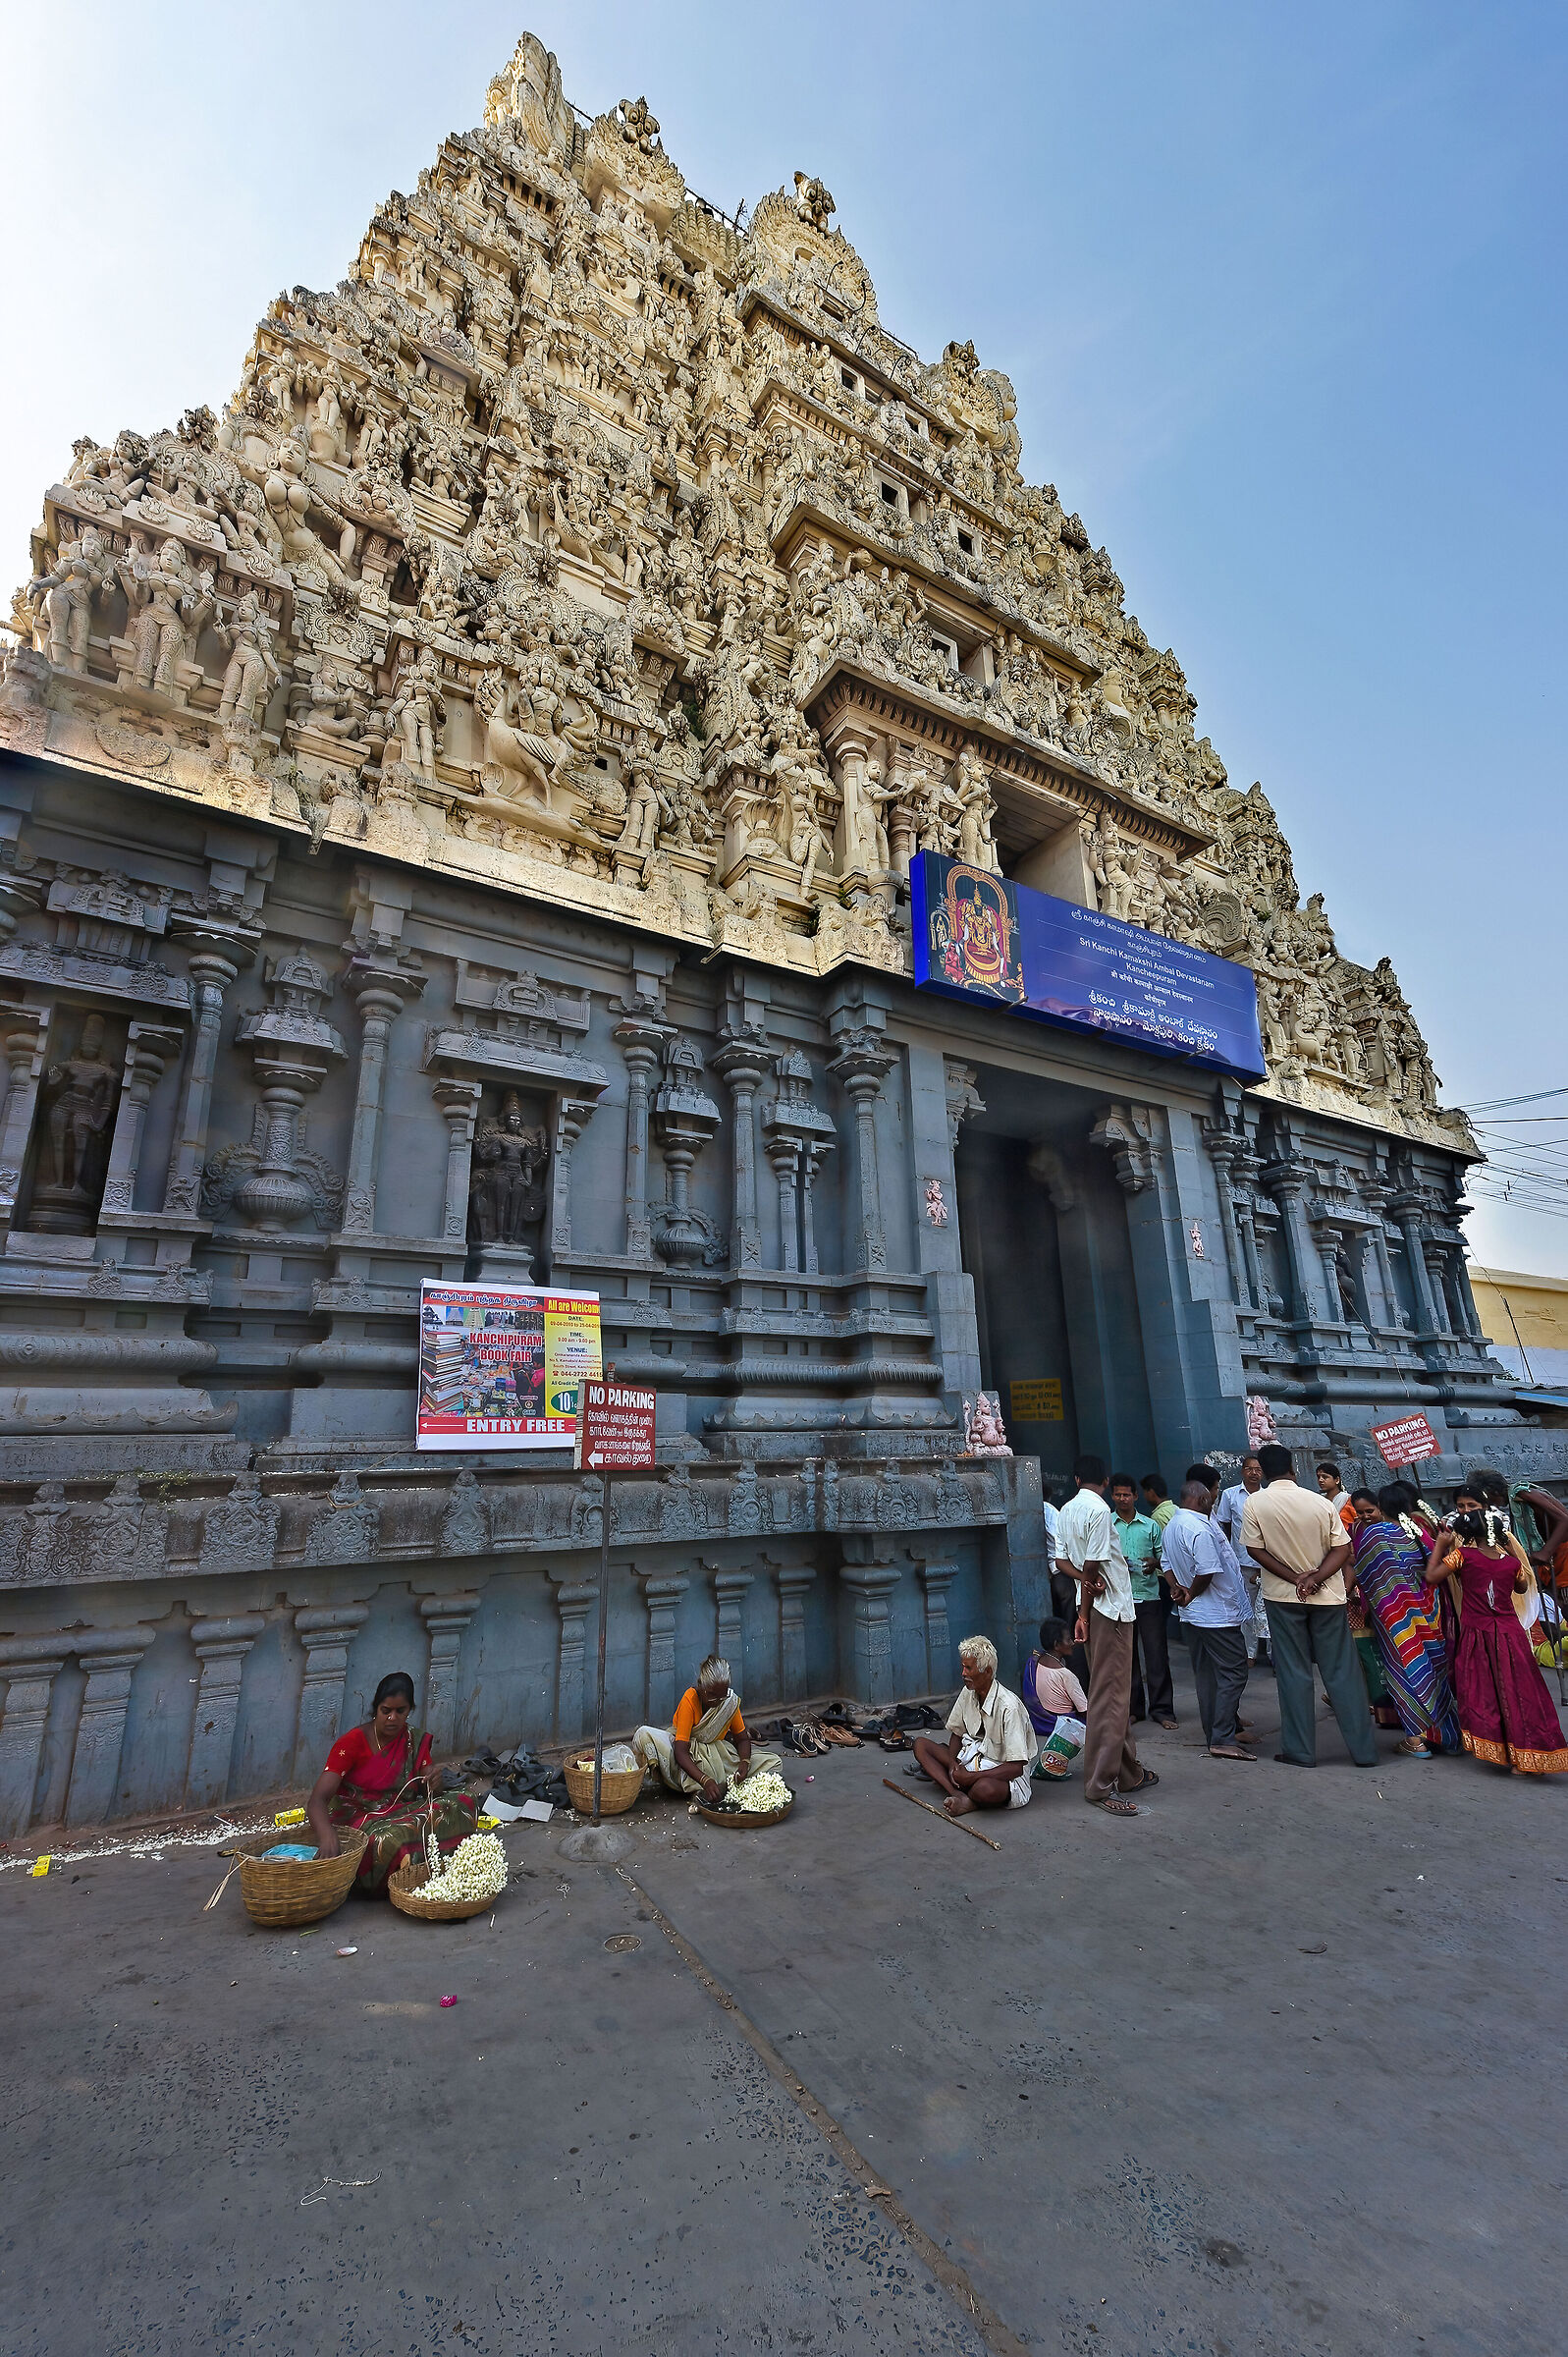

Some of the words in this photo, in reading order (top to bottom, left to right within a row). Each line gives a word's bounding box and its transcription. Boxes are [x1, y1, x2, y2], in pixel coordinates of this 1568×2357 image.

[1079, 937, 1091, 948] Sri
[1092, 941, 1117, 957] Kanchi
[1118, 950, 1153, 968] Kamakshi
[1154, 961, 1175, 975] Ambal
[1176, 968, 1215, 989] Devastanam
[1126, 962, 1177, 986] Kancheepuram
[548, 1299, 558, 1311] All
[559, 1301, 570, 1312] are
[570, 1301, 600, 1314] Welcom
[469, 1333, 542, 1346] KANCHIPURAM
[480, 1349, 509, 1362] BOOK
[510, 1350, 532, 1362] FAIR
[589, 1386, 605, 1404] NO
[609, 1388, 655, 1409] PARKING
[466, 1419, 522, 1433] ENTRY
[527, 1419, 566, 1433] FREE
[1376, 1430, 1388, 1442] NO
[1388, 1418, 1427, 1438] PARKING
